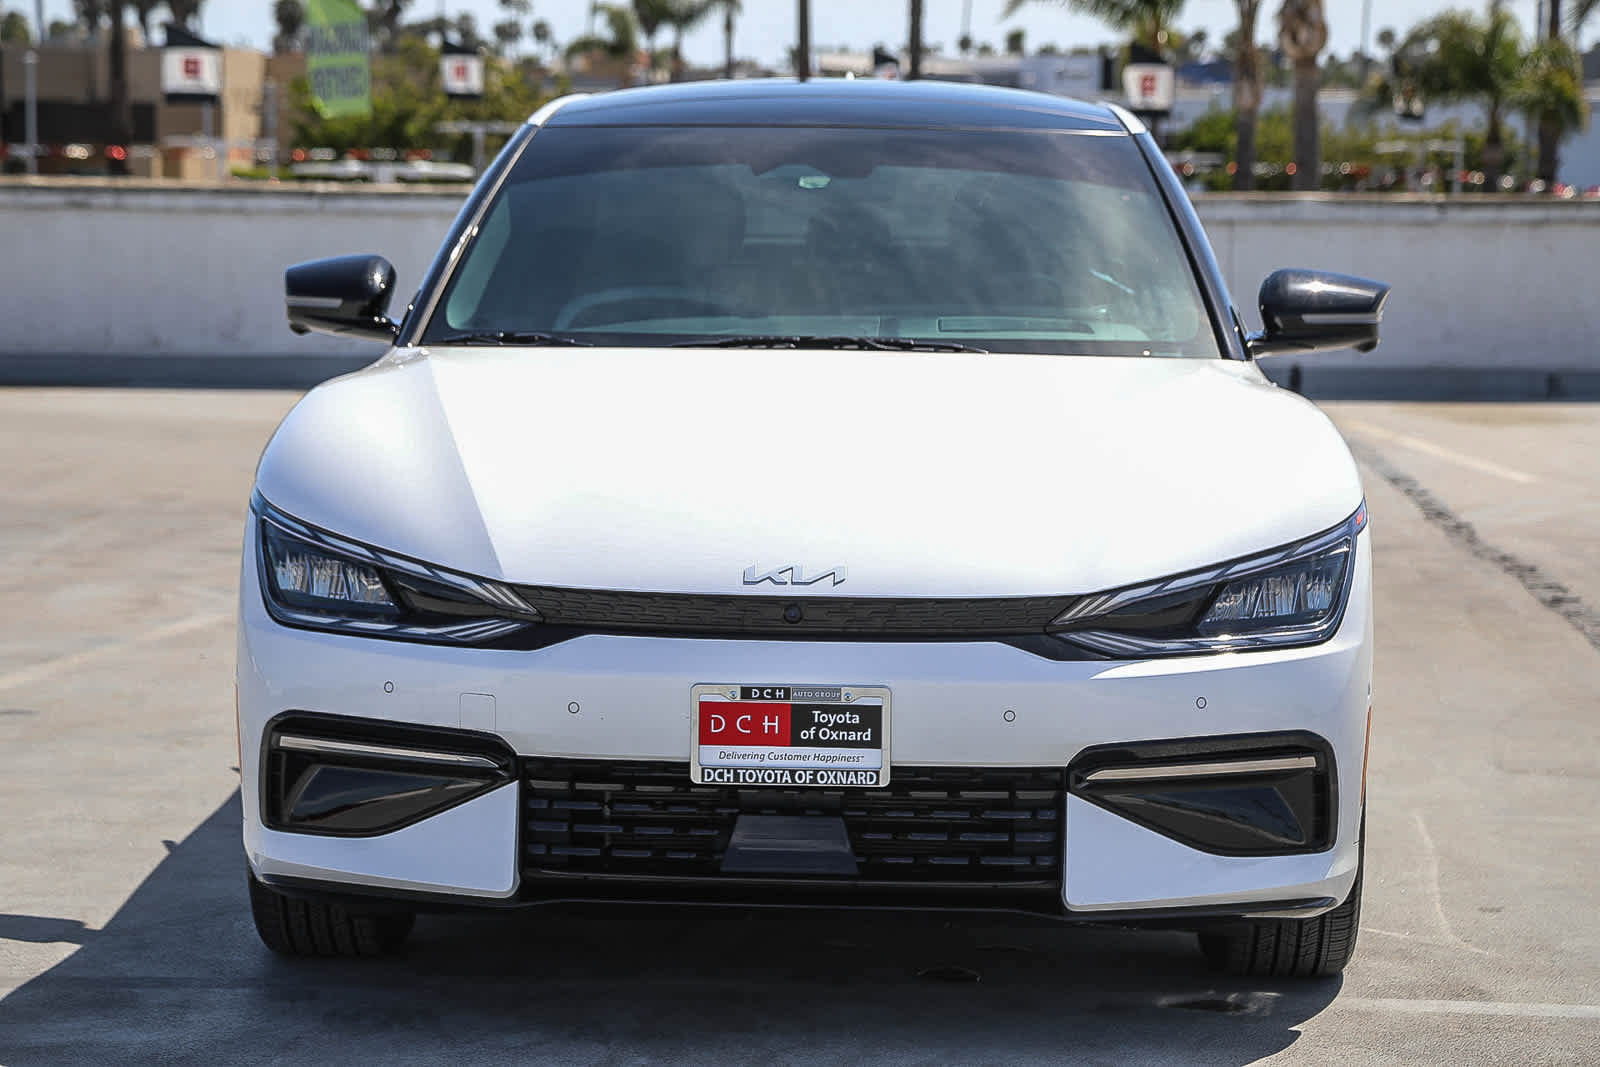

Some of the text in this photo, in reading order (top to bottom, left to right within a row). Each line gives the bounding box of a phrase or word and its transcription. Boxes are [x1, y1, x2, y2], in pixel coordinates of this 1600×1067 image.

[742, 564, 847, 587] KIA
[812, 710, 860, 727] Toyota
[800, 726, 872, 741] of Oxnard
[719, 750, 766, 762] Delivering
[767, 751, 811, 762] Customer
[703, 768, 877, 785] DCH TOYOTA OF OXNARD
